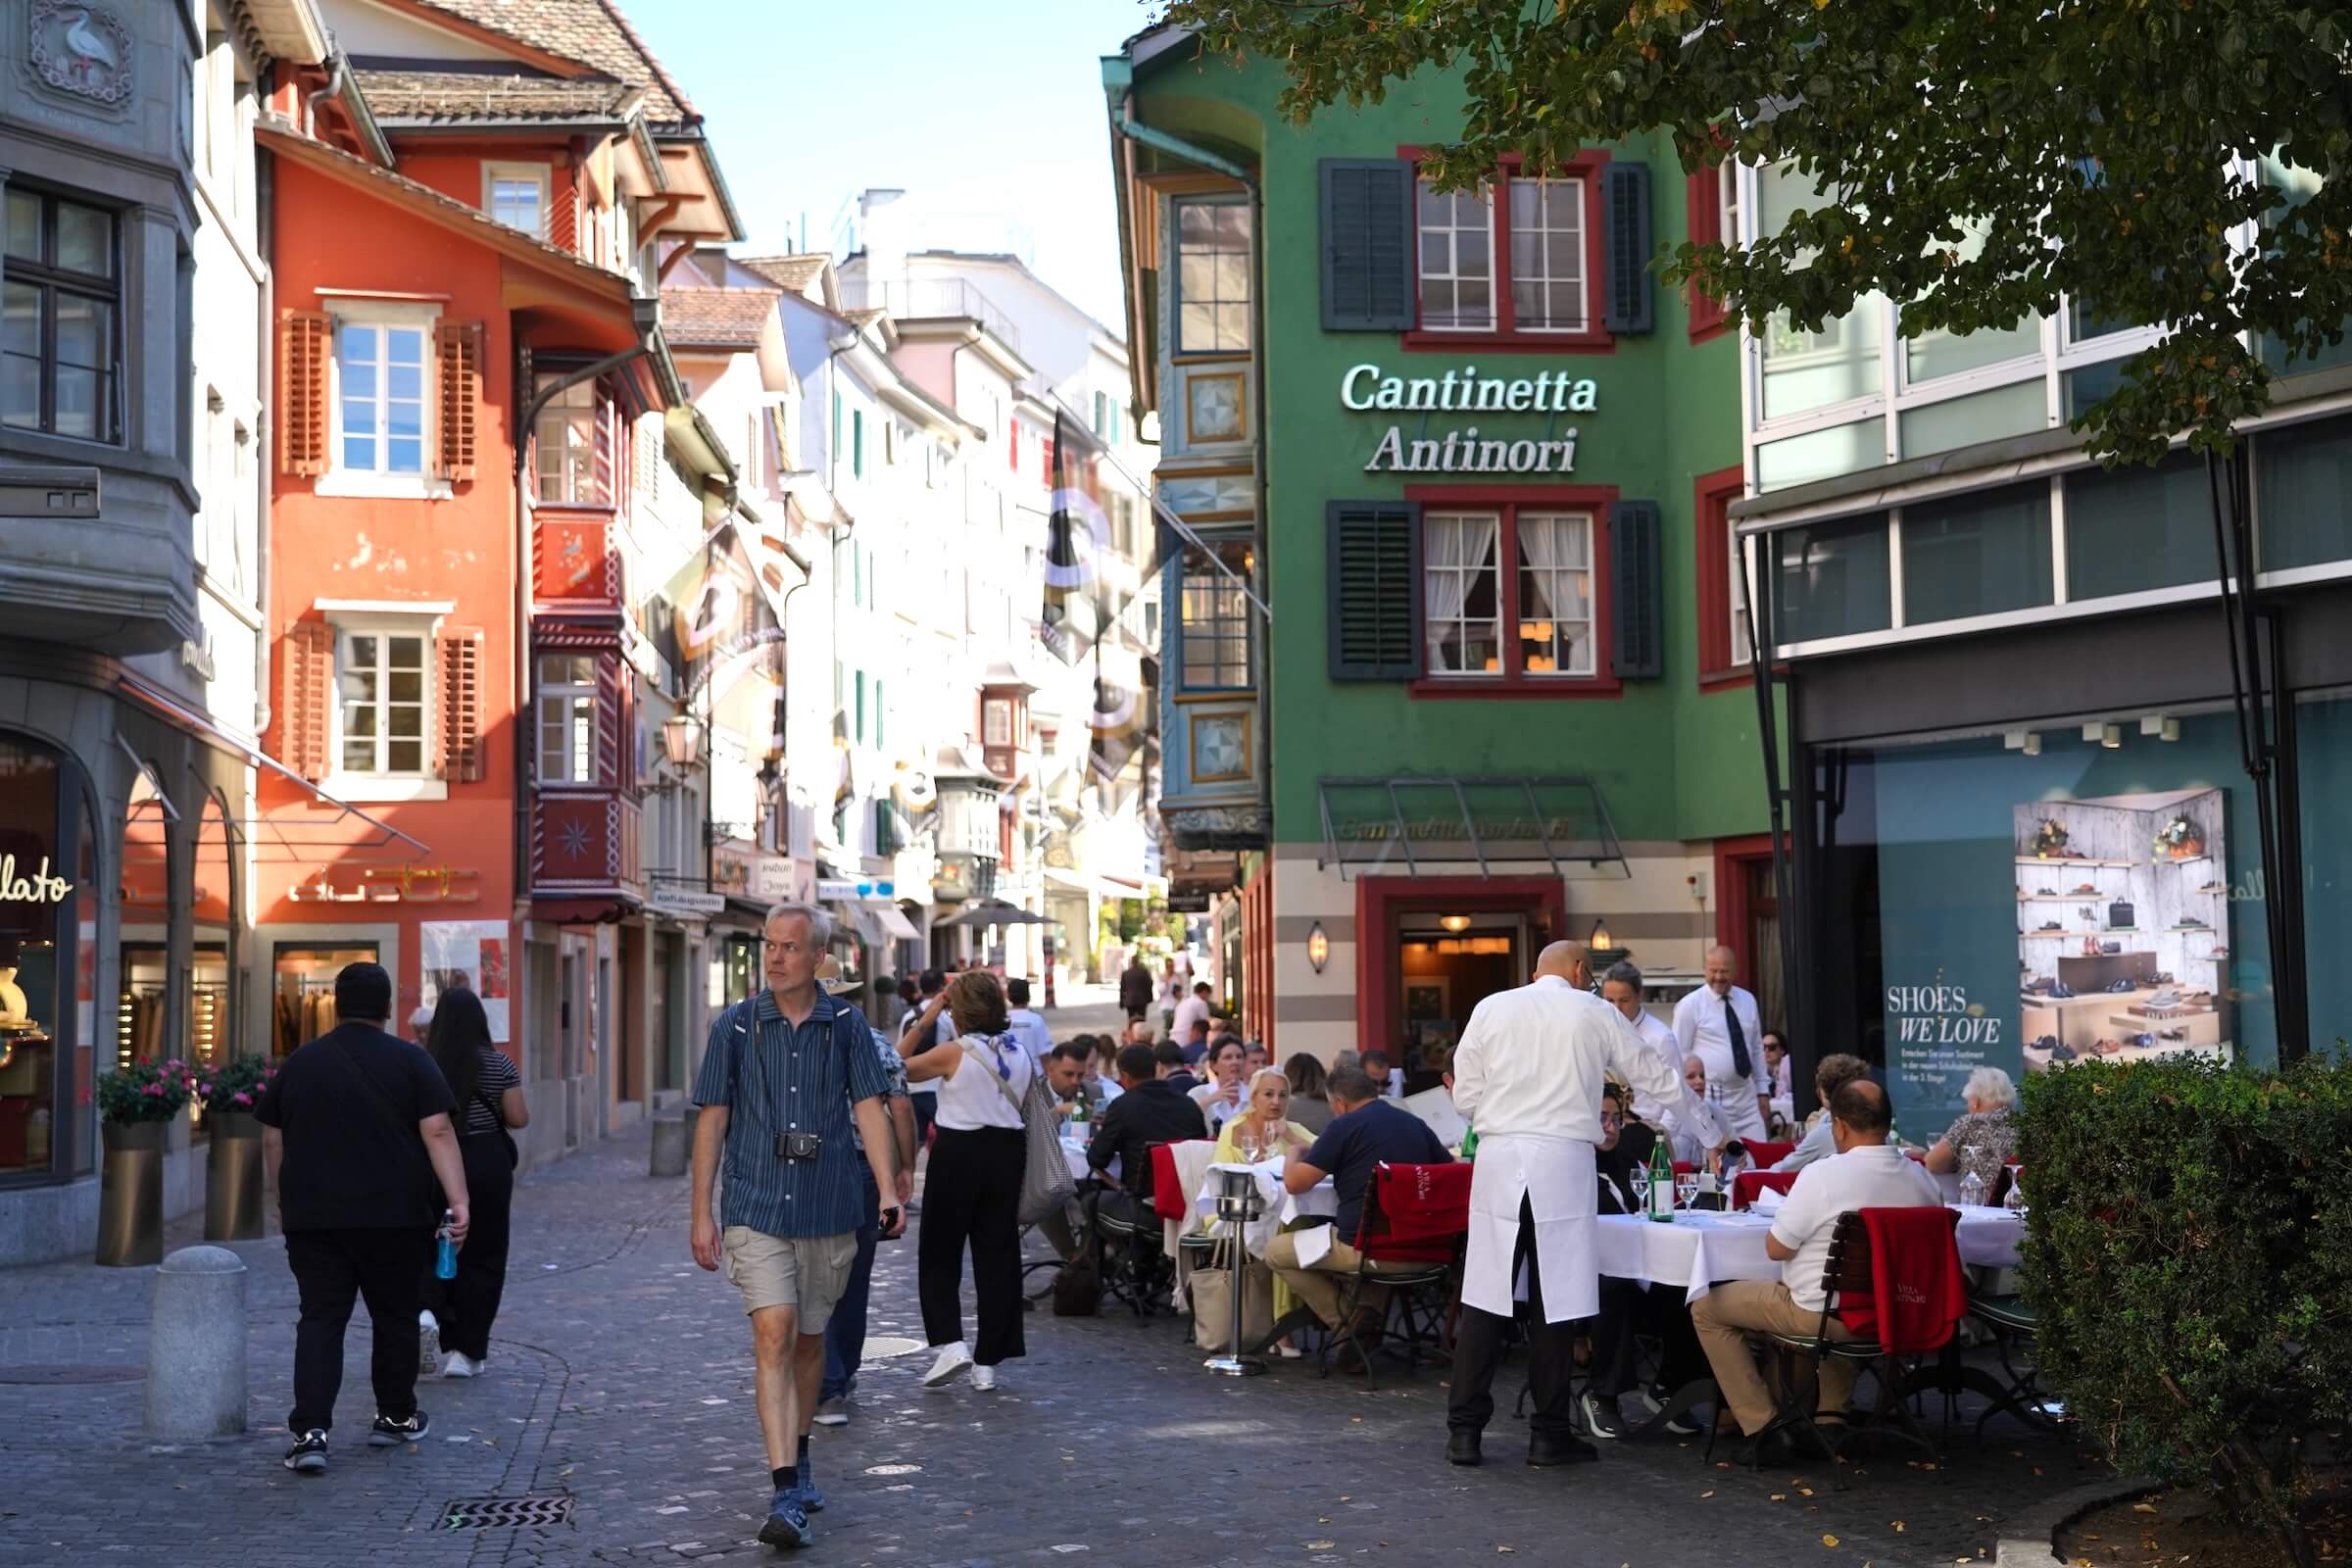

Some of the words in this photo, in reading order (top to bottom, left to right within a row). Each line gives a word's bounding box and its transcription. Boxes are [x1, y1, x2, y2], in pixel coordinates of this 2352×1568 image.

[1341, 364, 1597, 412] Cantinetta
[1364, 425, 1578, 472] Antinori
[0, 853, 74, 904] lato
[1887, 986, 1967, 1013] SHOES
[1900, 1017, 1935, 1043] WE
[1938, 1017, 2001, 1044] LOVE
